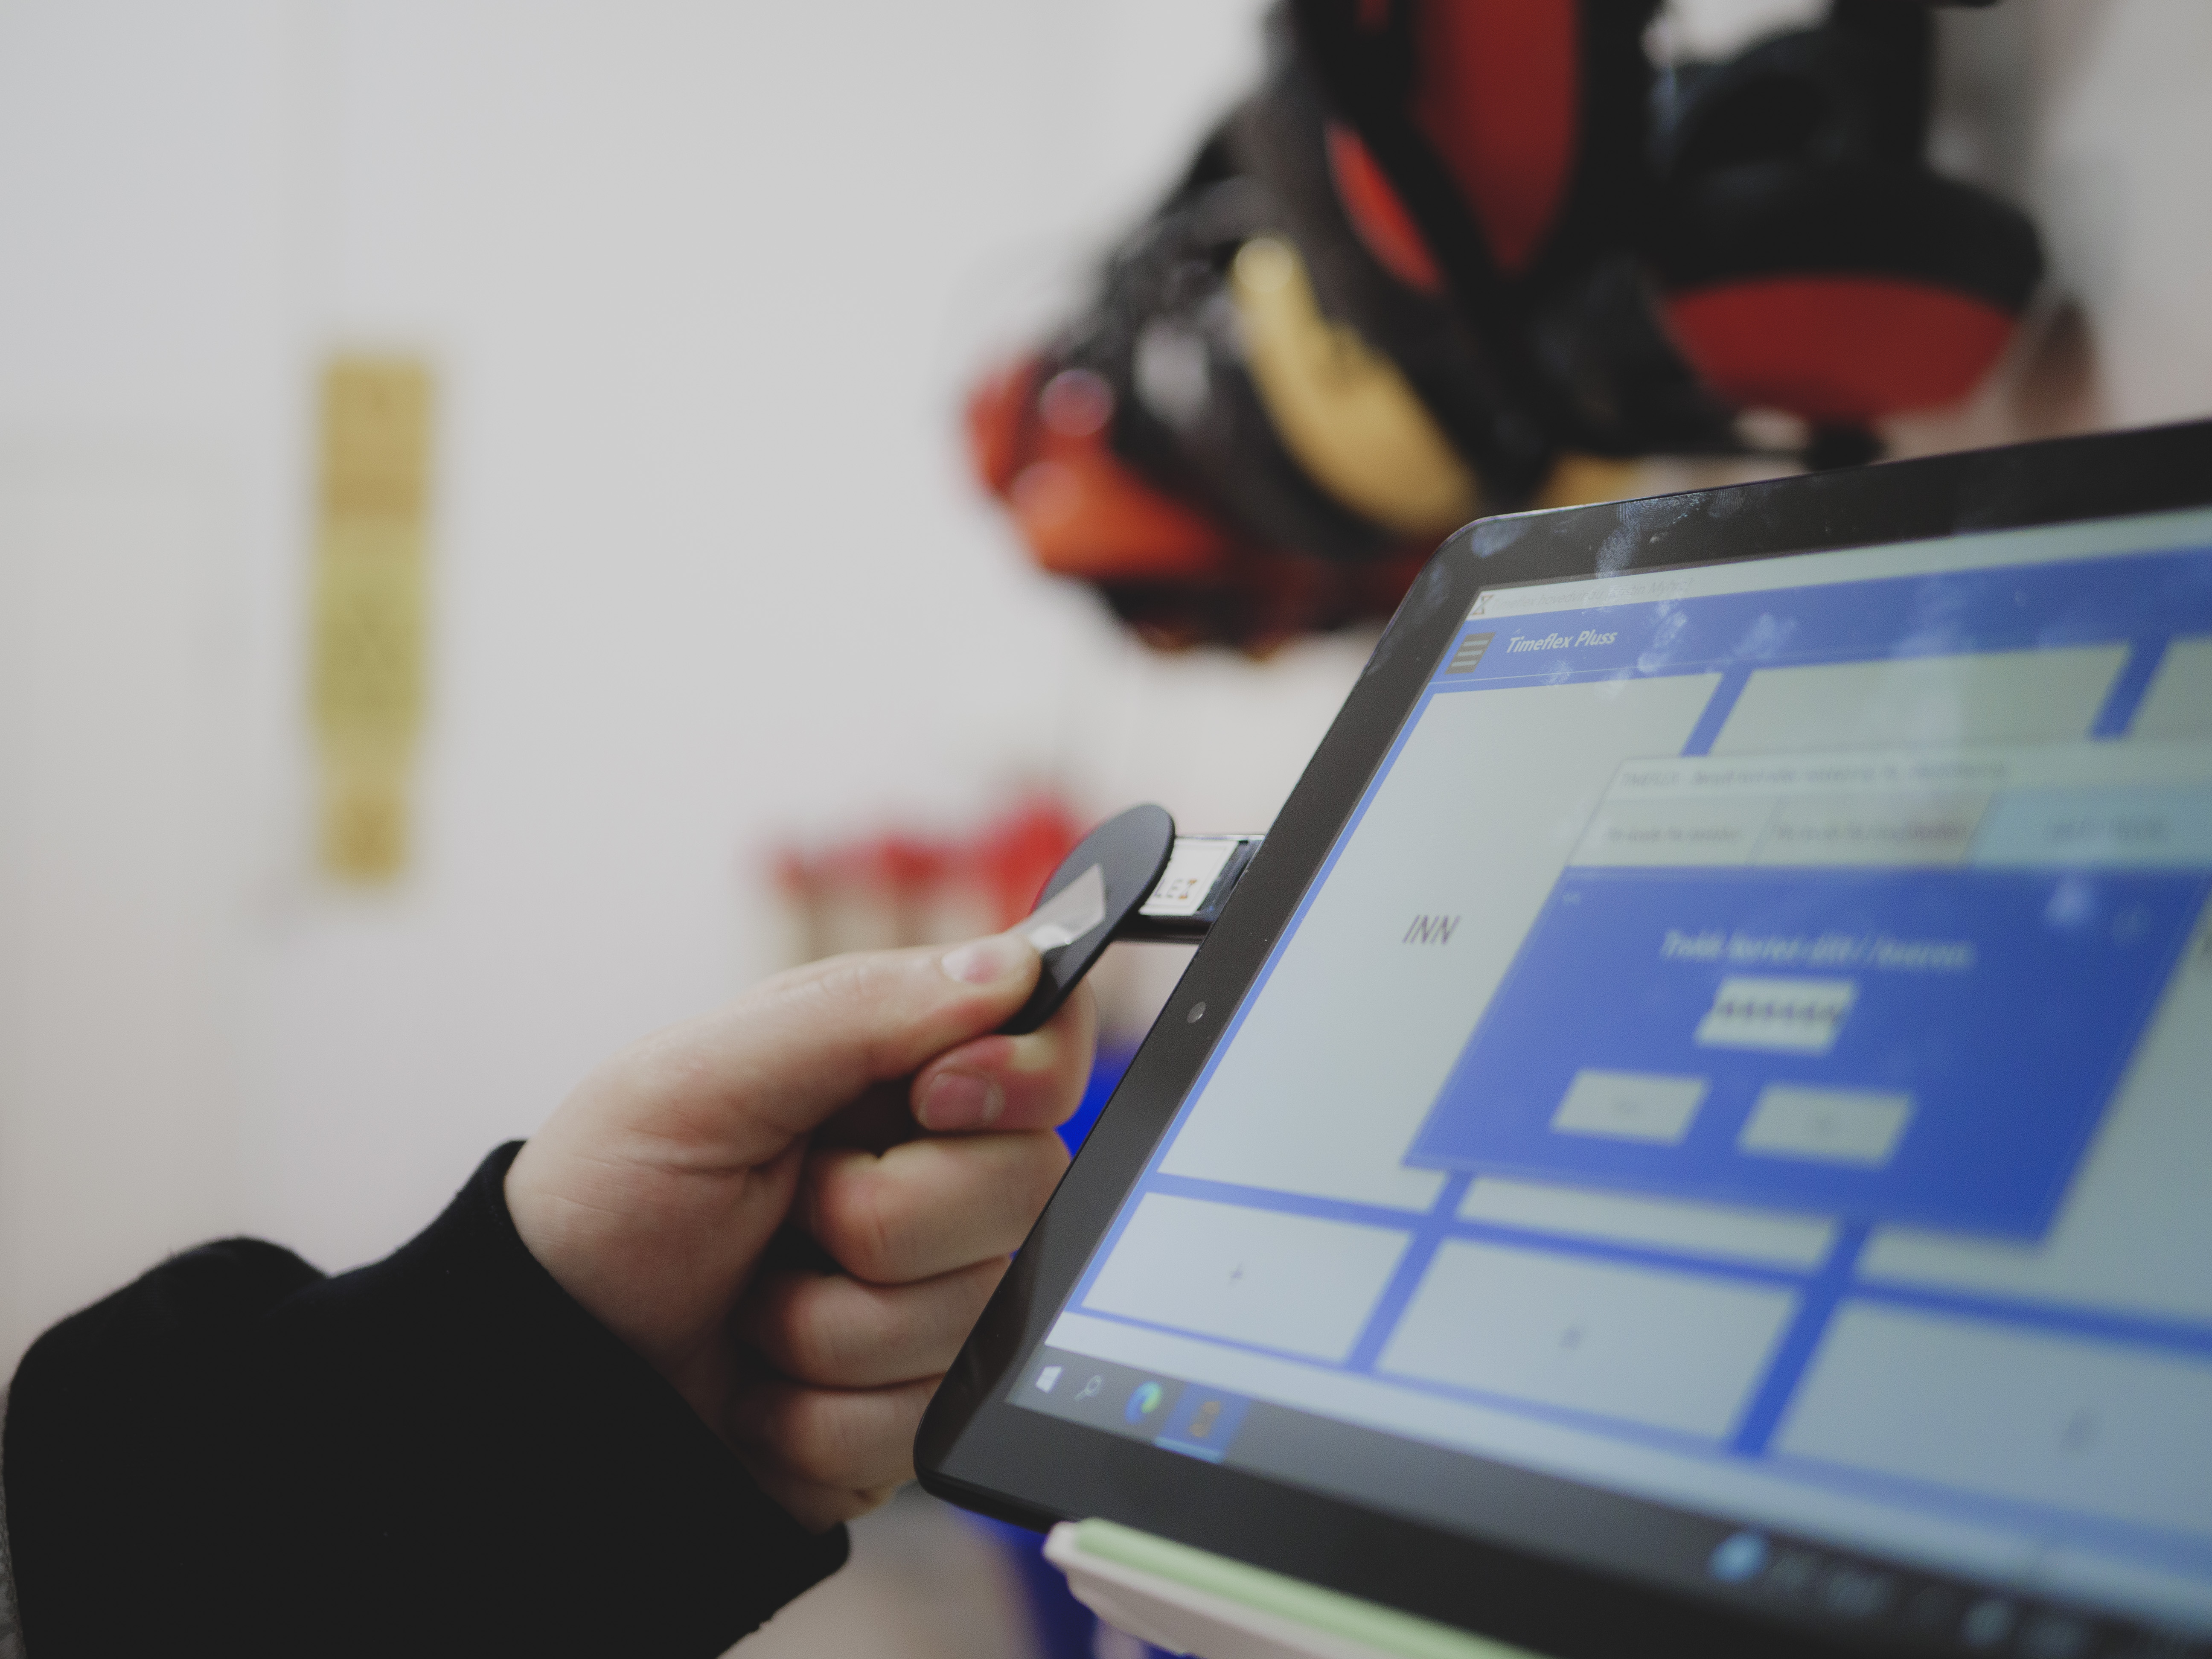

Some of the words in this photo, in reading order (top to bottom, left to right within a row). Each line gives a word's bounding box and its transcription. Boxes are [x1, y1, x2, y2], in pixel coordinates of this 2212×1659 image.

[1506, 633, 1574, 653] Timeflex
[1574, 629, 1618, 647] Pluss
[1402, 914, 1461, 944] INN
